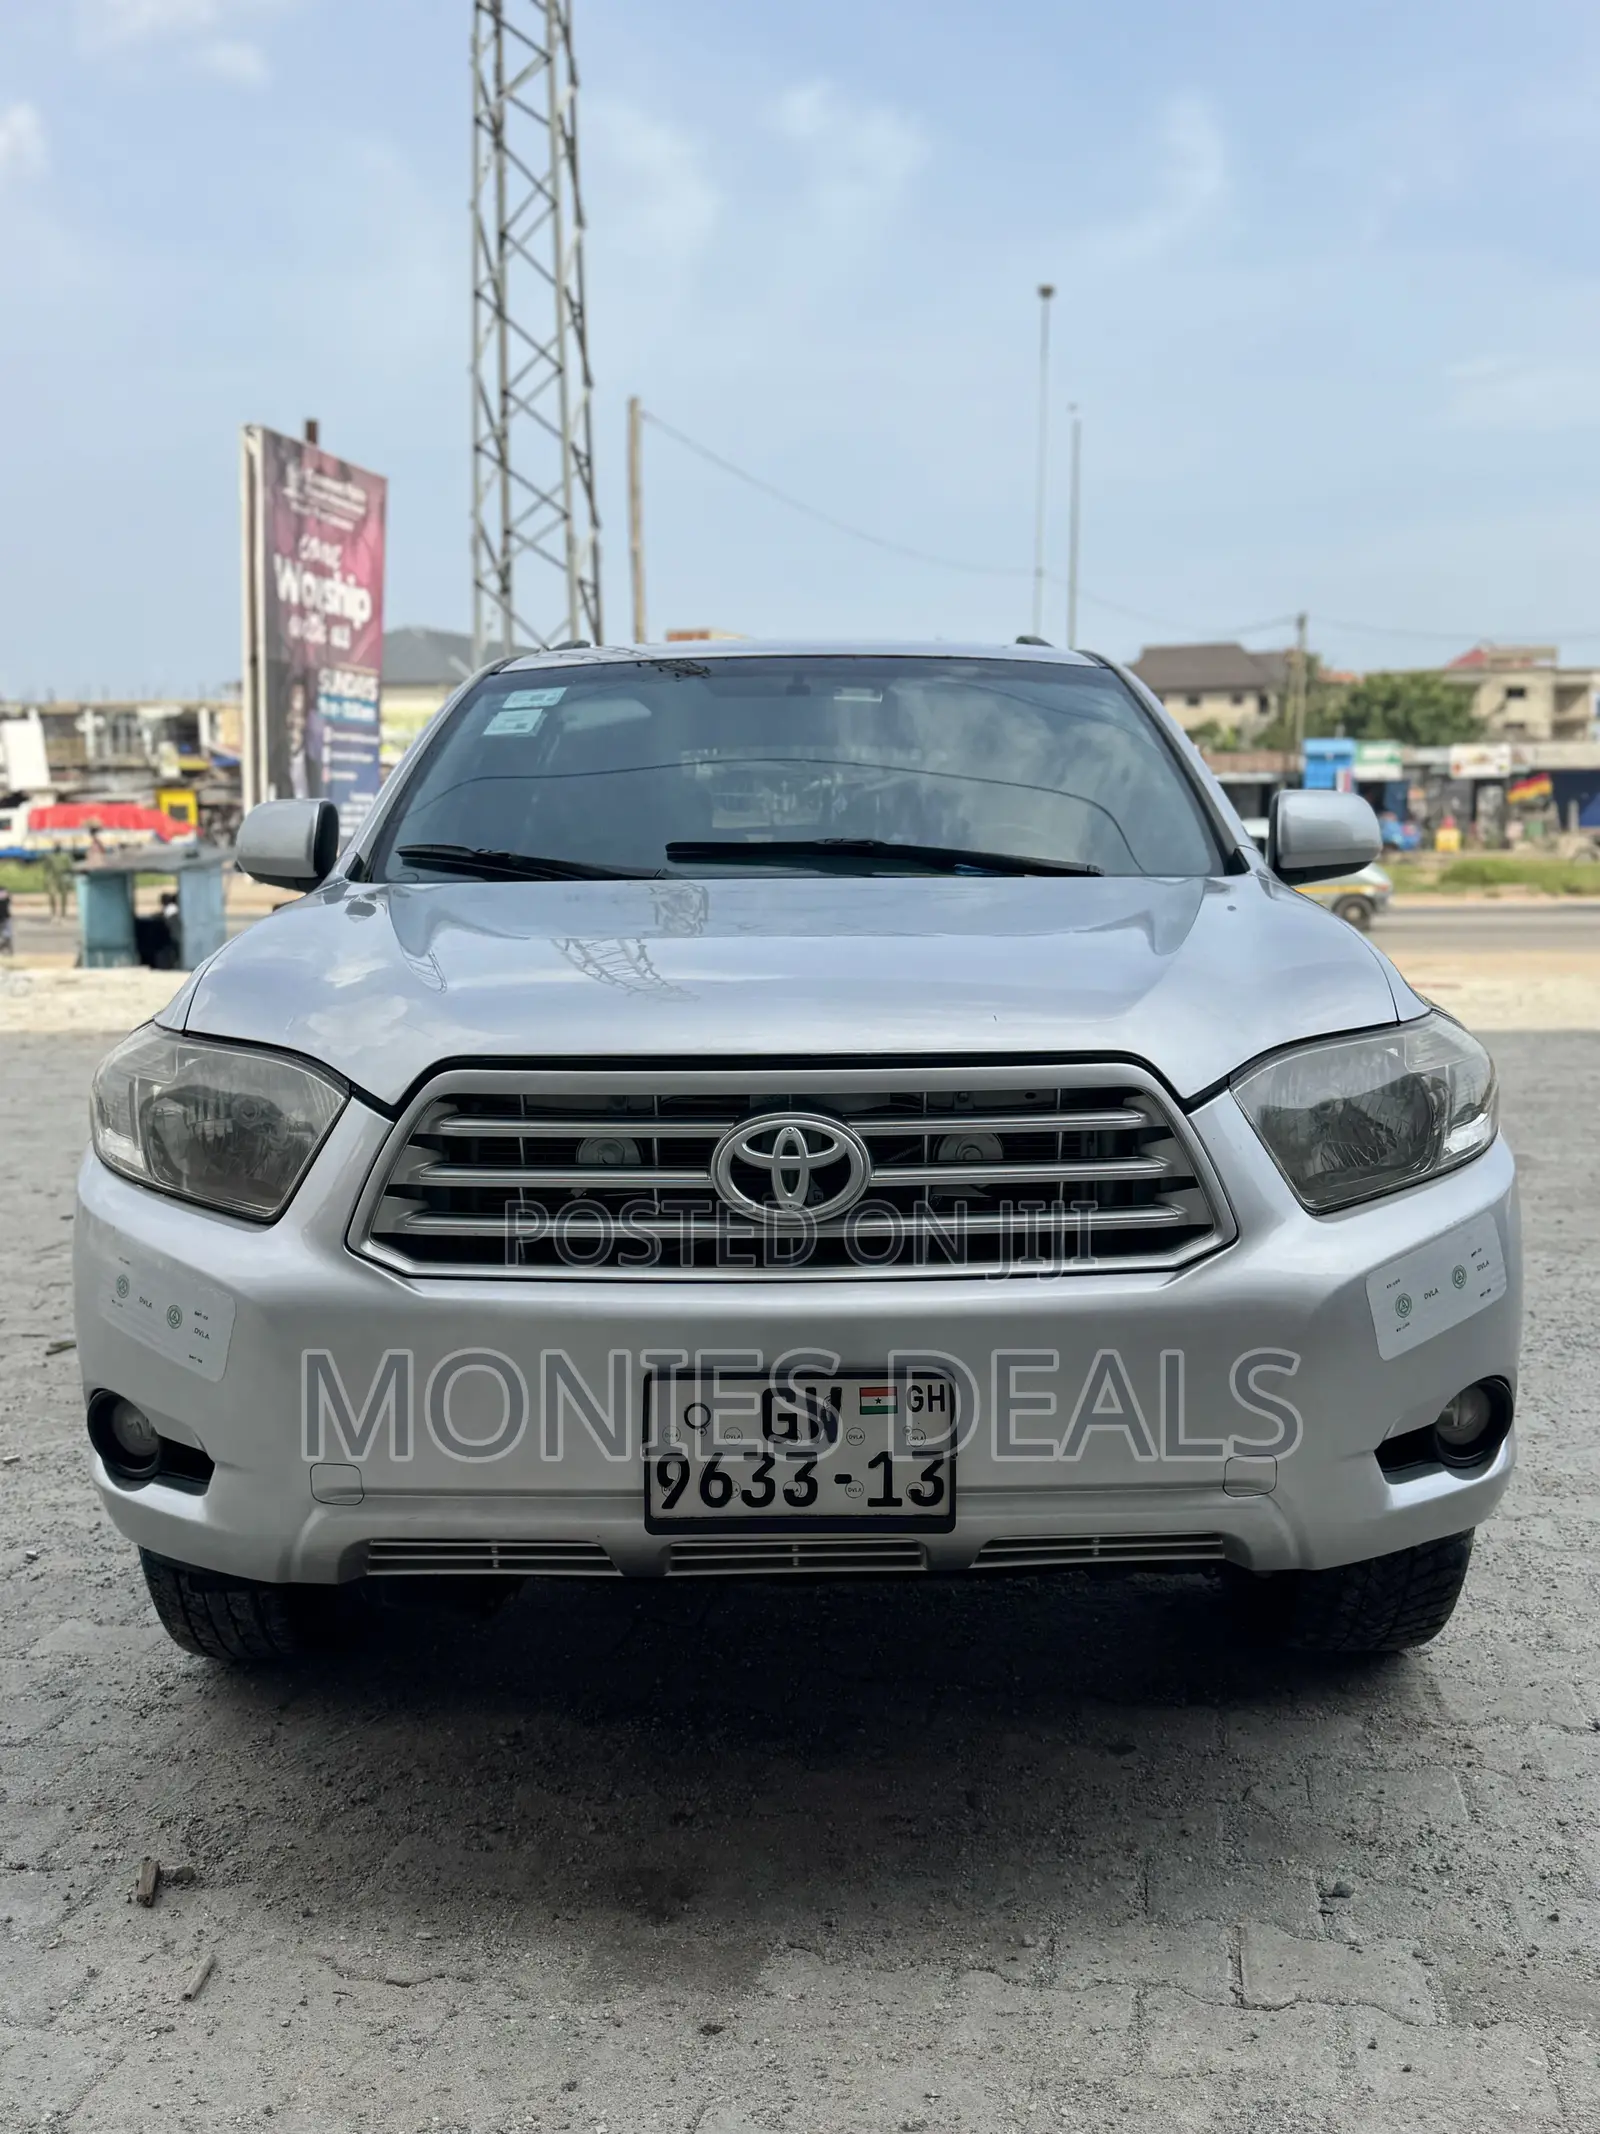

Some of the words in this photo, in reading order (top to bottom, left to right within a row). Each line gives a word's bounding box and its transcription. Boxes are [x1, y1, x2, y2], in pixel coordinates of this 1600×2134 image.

[273, 552, 372, 630] Worship
[1424, 1287, 1440, 1300] DVLA
[194, 1327, 210, 1340] DVLA
[907, 1384, 946, 1413] GH
[657, 1450, 945, 1510] 9633-13
